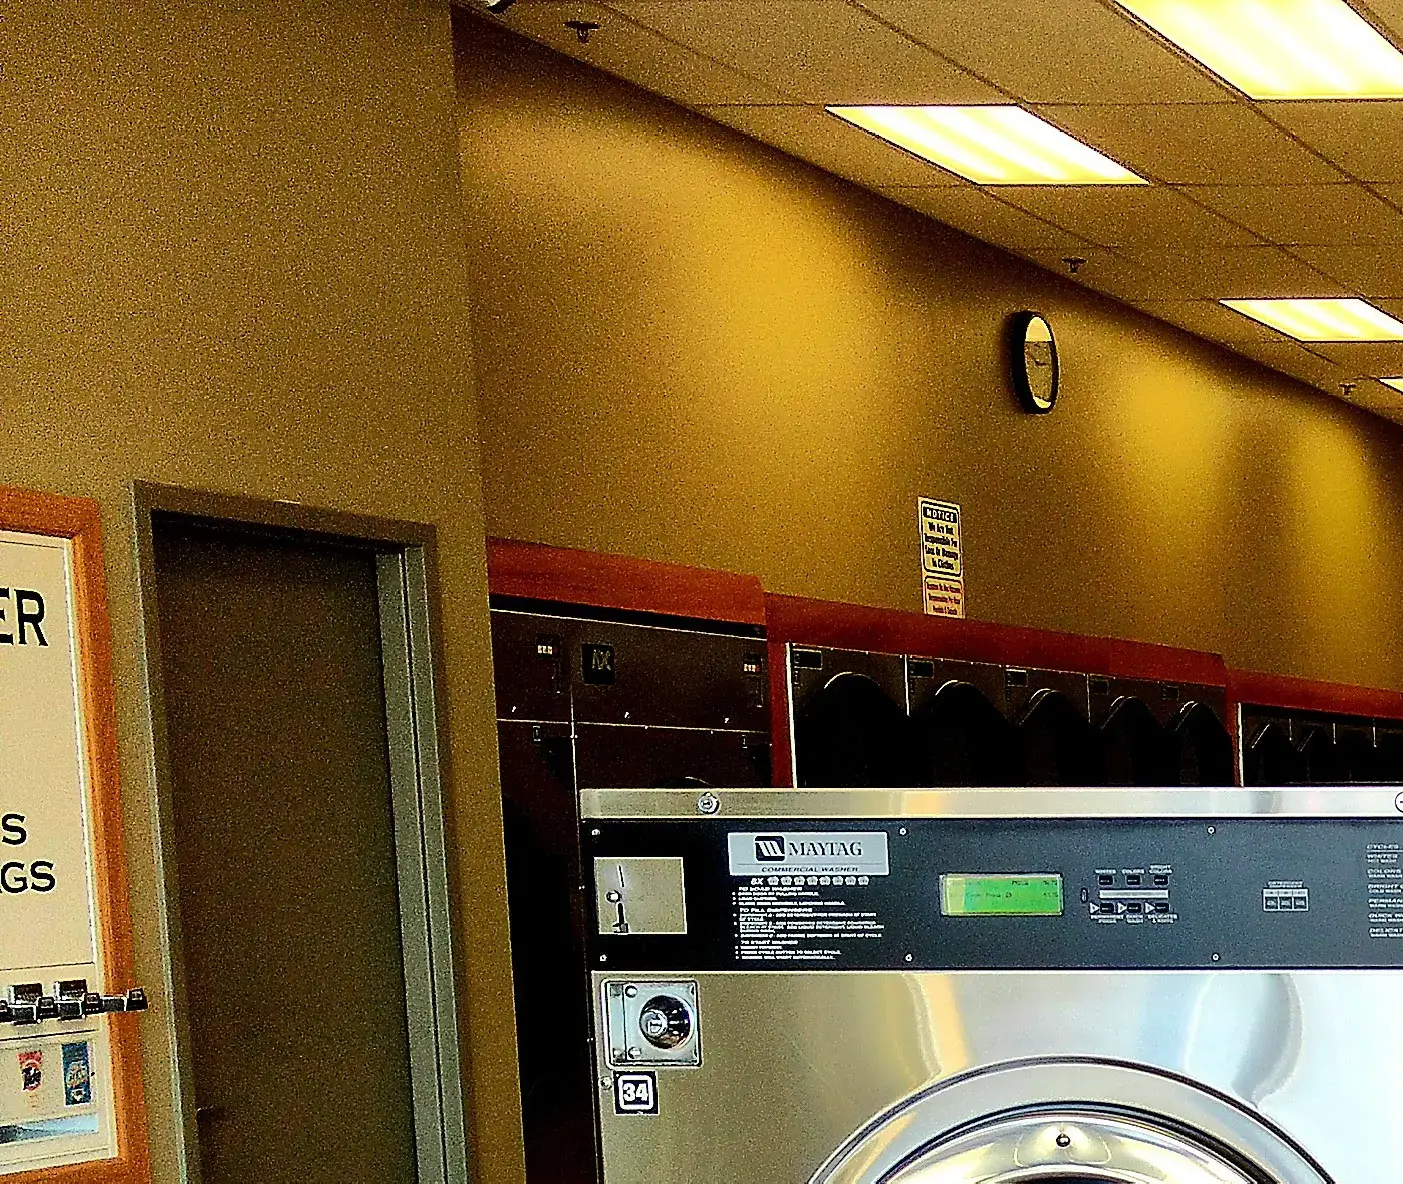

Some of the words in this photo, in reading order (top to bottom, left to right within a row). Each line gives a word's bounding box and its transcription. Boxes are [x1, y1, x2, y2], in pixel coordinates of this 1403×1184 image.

[926, 508, 954, 522] NOTICE
[788, 842, 862, 856] MAYTAG
[0, 860, 56, 894] GS
[623, 1082, 648, 1101] 34
